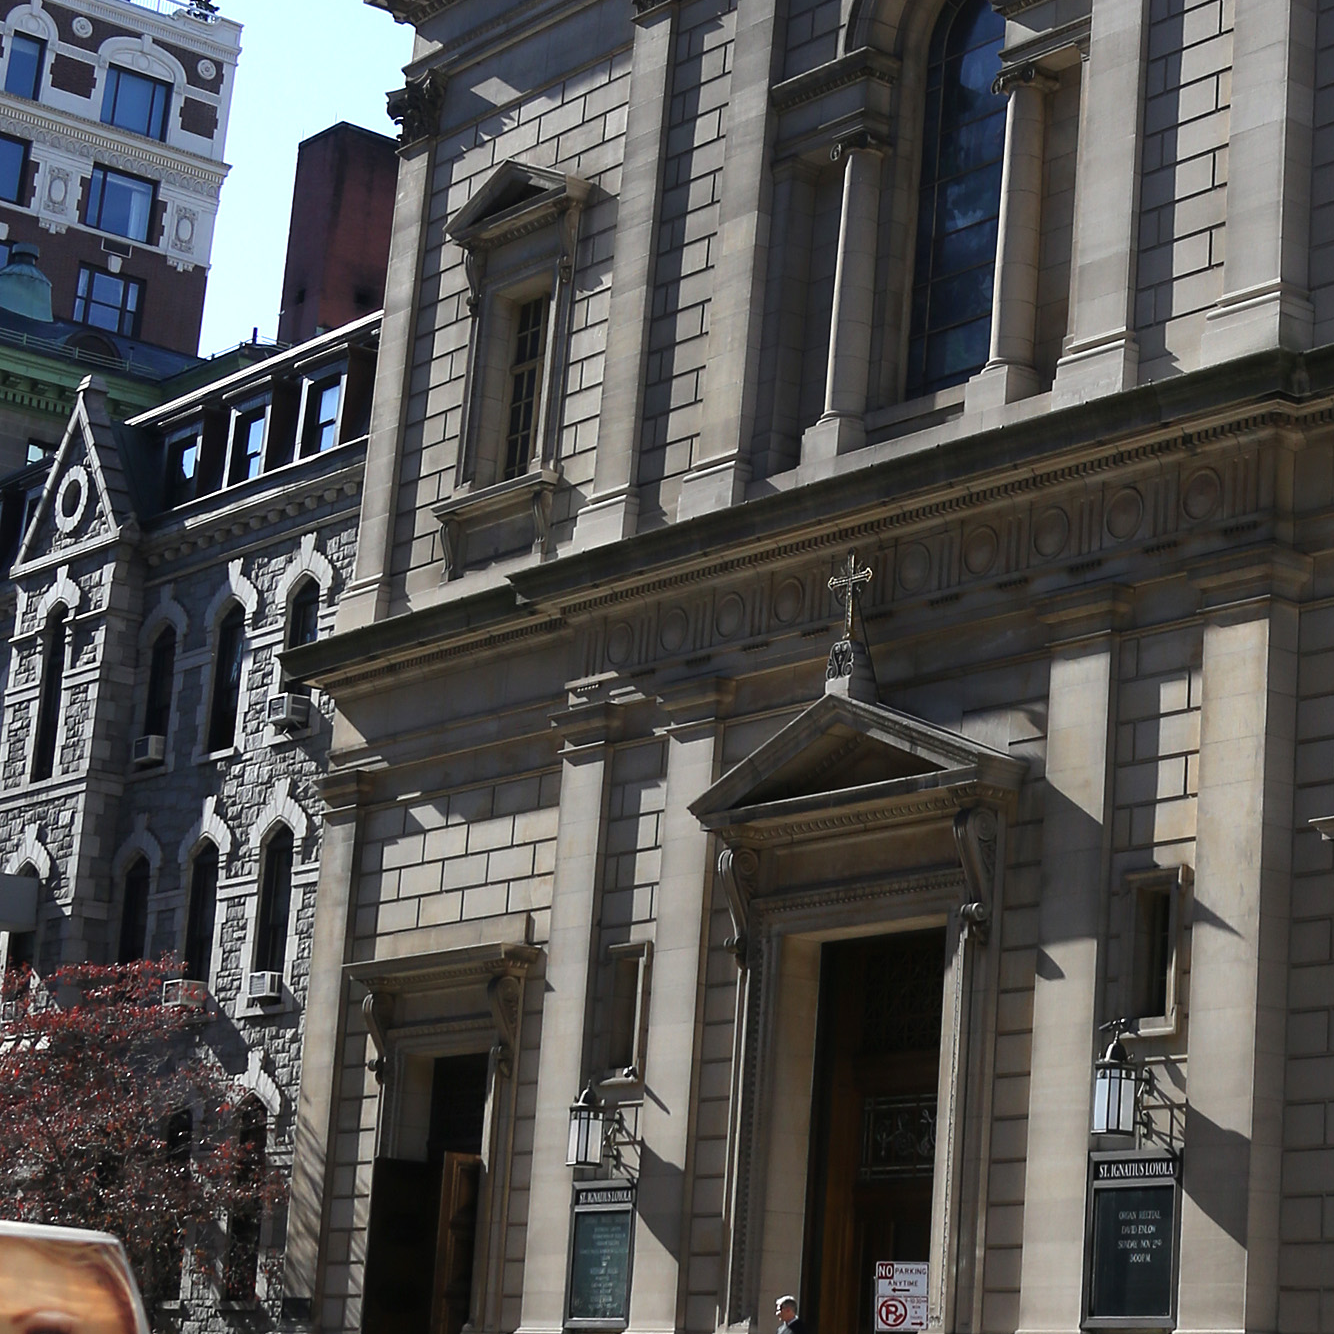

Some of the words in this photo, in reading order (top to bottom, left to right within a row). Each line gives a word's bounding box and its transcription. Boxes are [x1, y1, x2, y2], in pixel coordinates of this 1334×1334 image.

[1099, 1164, 1110, 1177] ST.
[1111, 1163, 1145, 1176] IGNATIUS
[1145, 1162, 1174, 1175] LOYOLA
[879, 1265, 893, 1277] NO
[895, 1267, 927, 1275] PARKING
